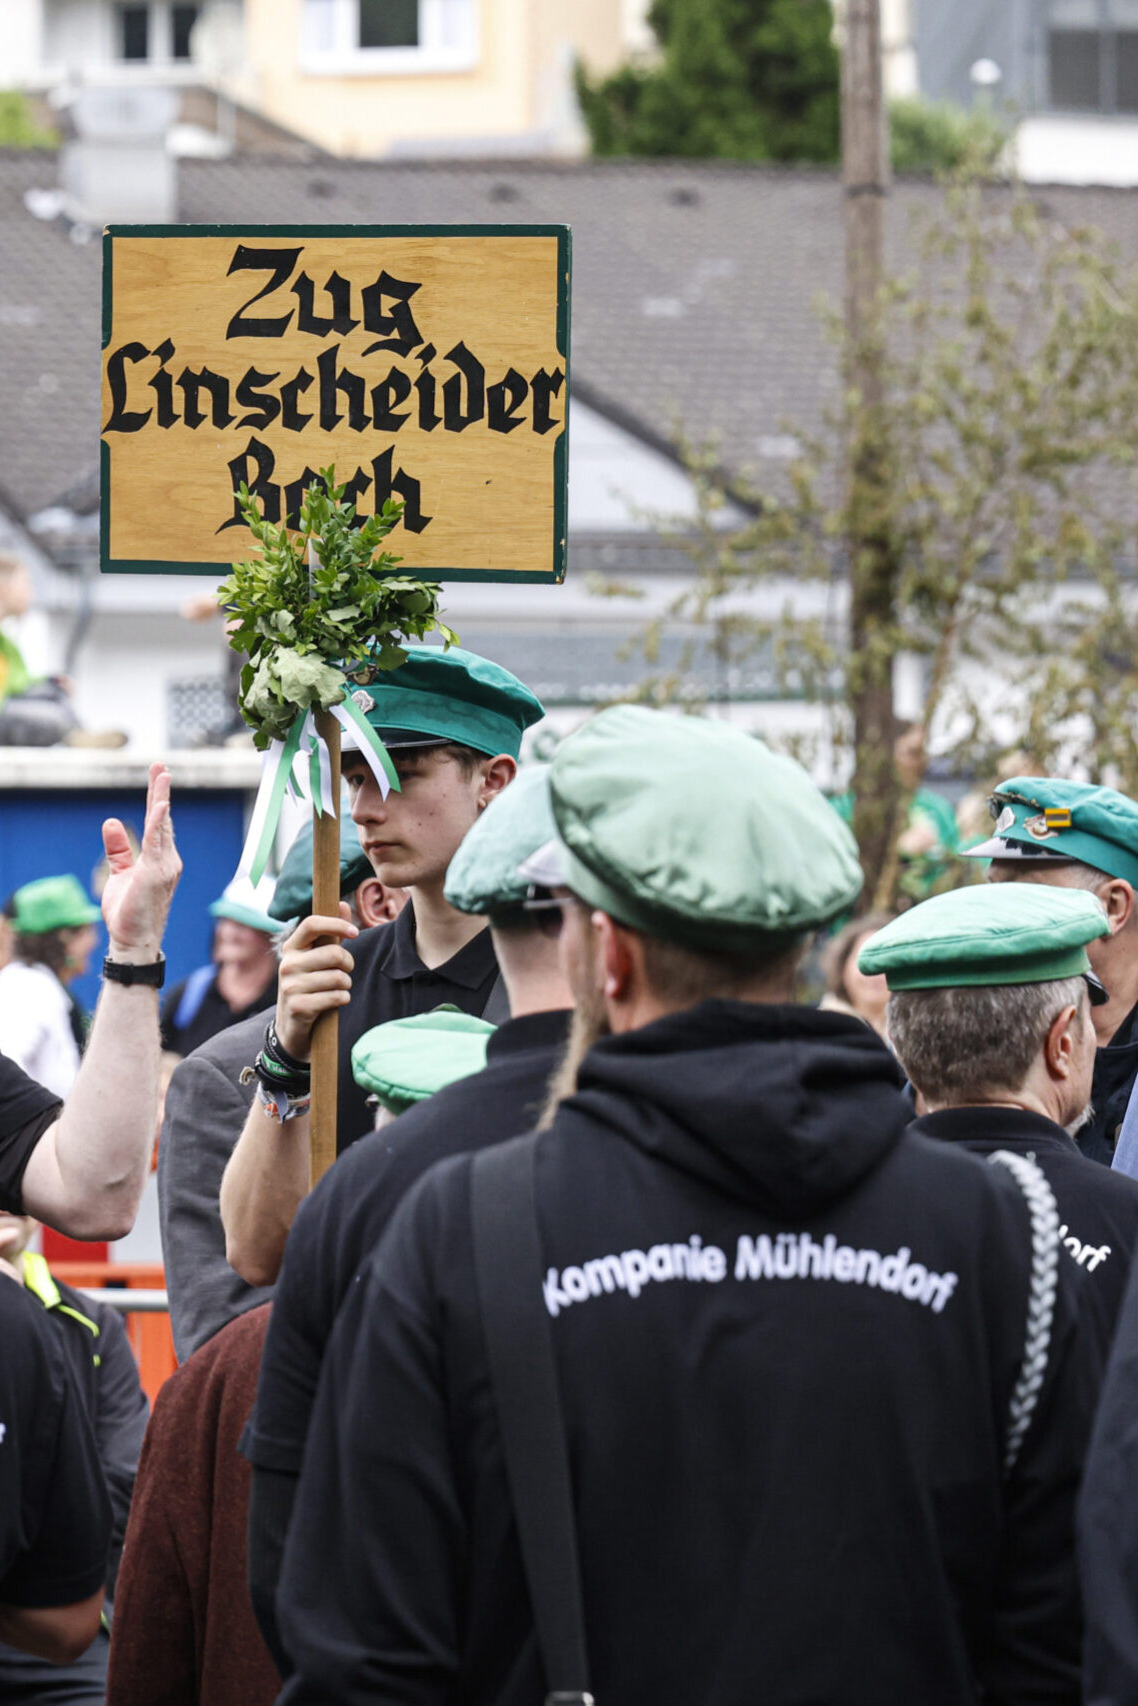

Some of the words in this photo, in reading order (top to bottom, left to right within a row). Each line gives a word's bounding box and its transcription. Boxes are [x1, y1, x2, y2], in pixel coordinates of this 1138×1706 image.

[226, 244, 424, 357] Zug
[101, 338, 565, 435] Linscheider
[543, 1235, 726, 1316] Kompanie
[735, 1233, 958, 1312] Mühlendorf
